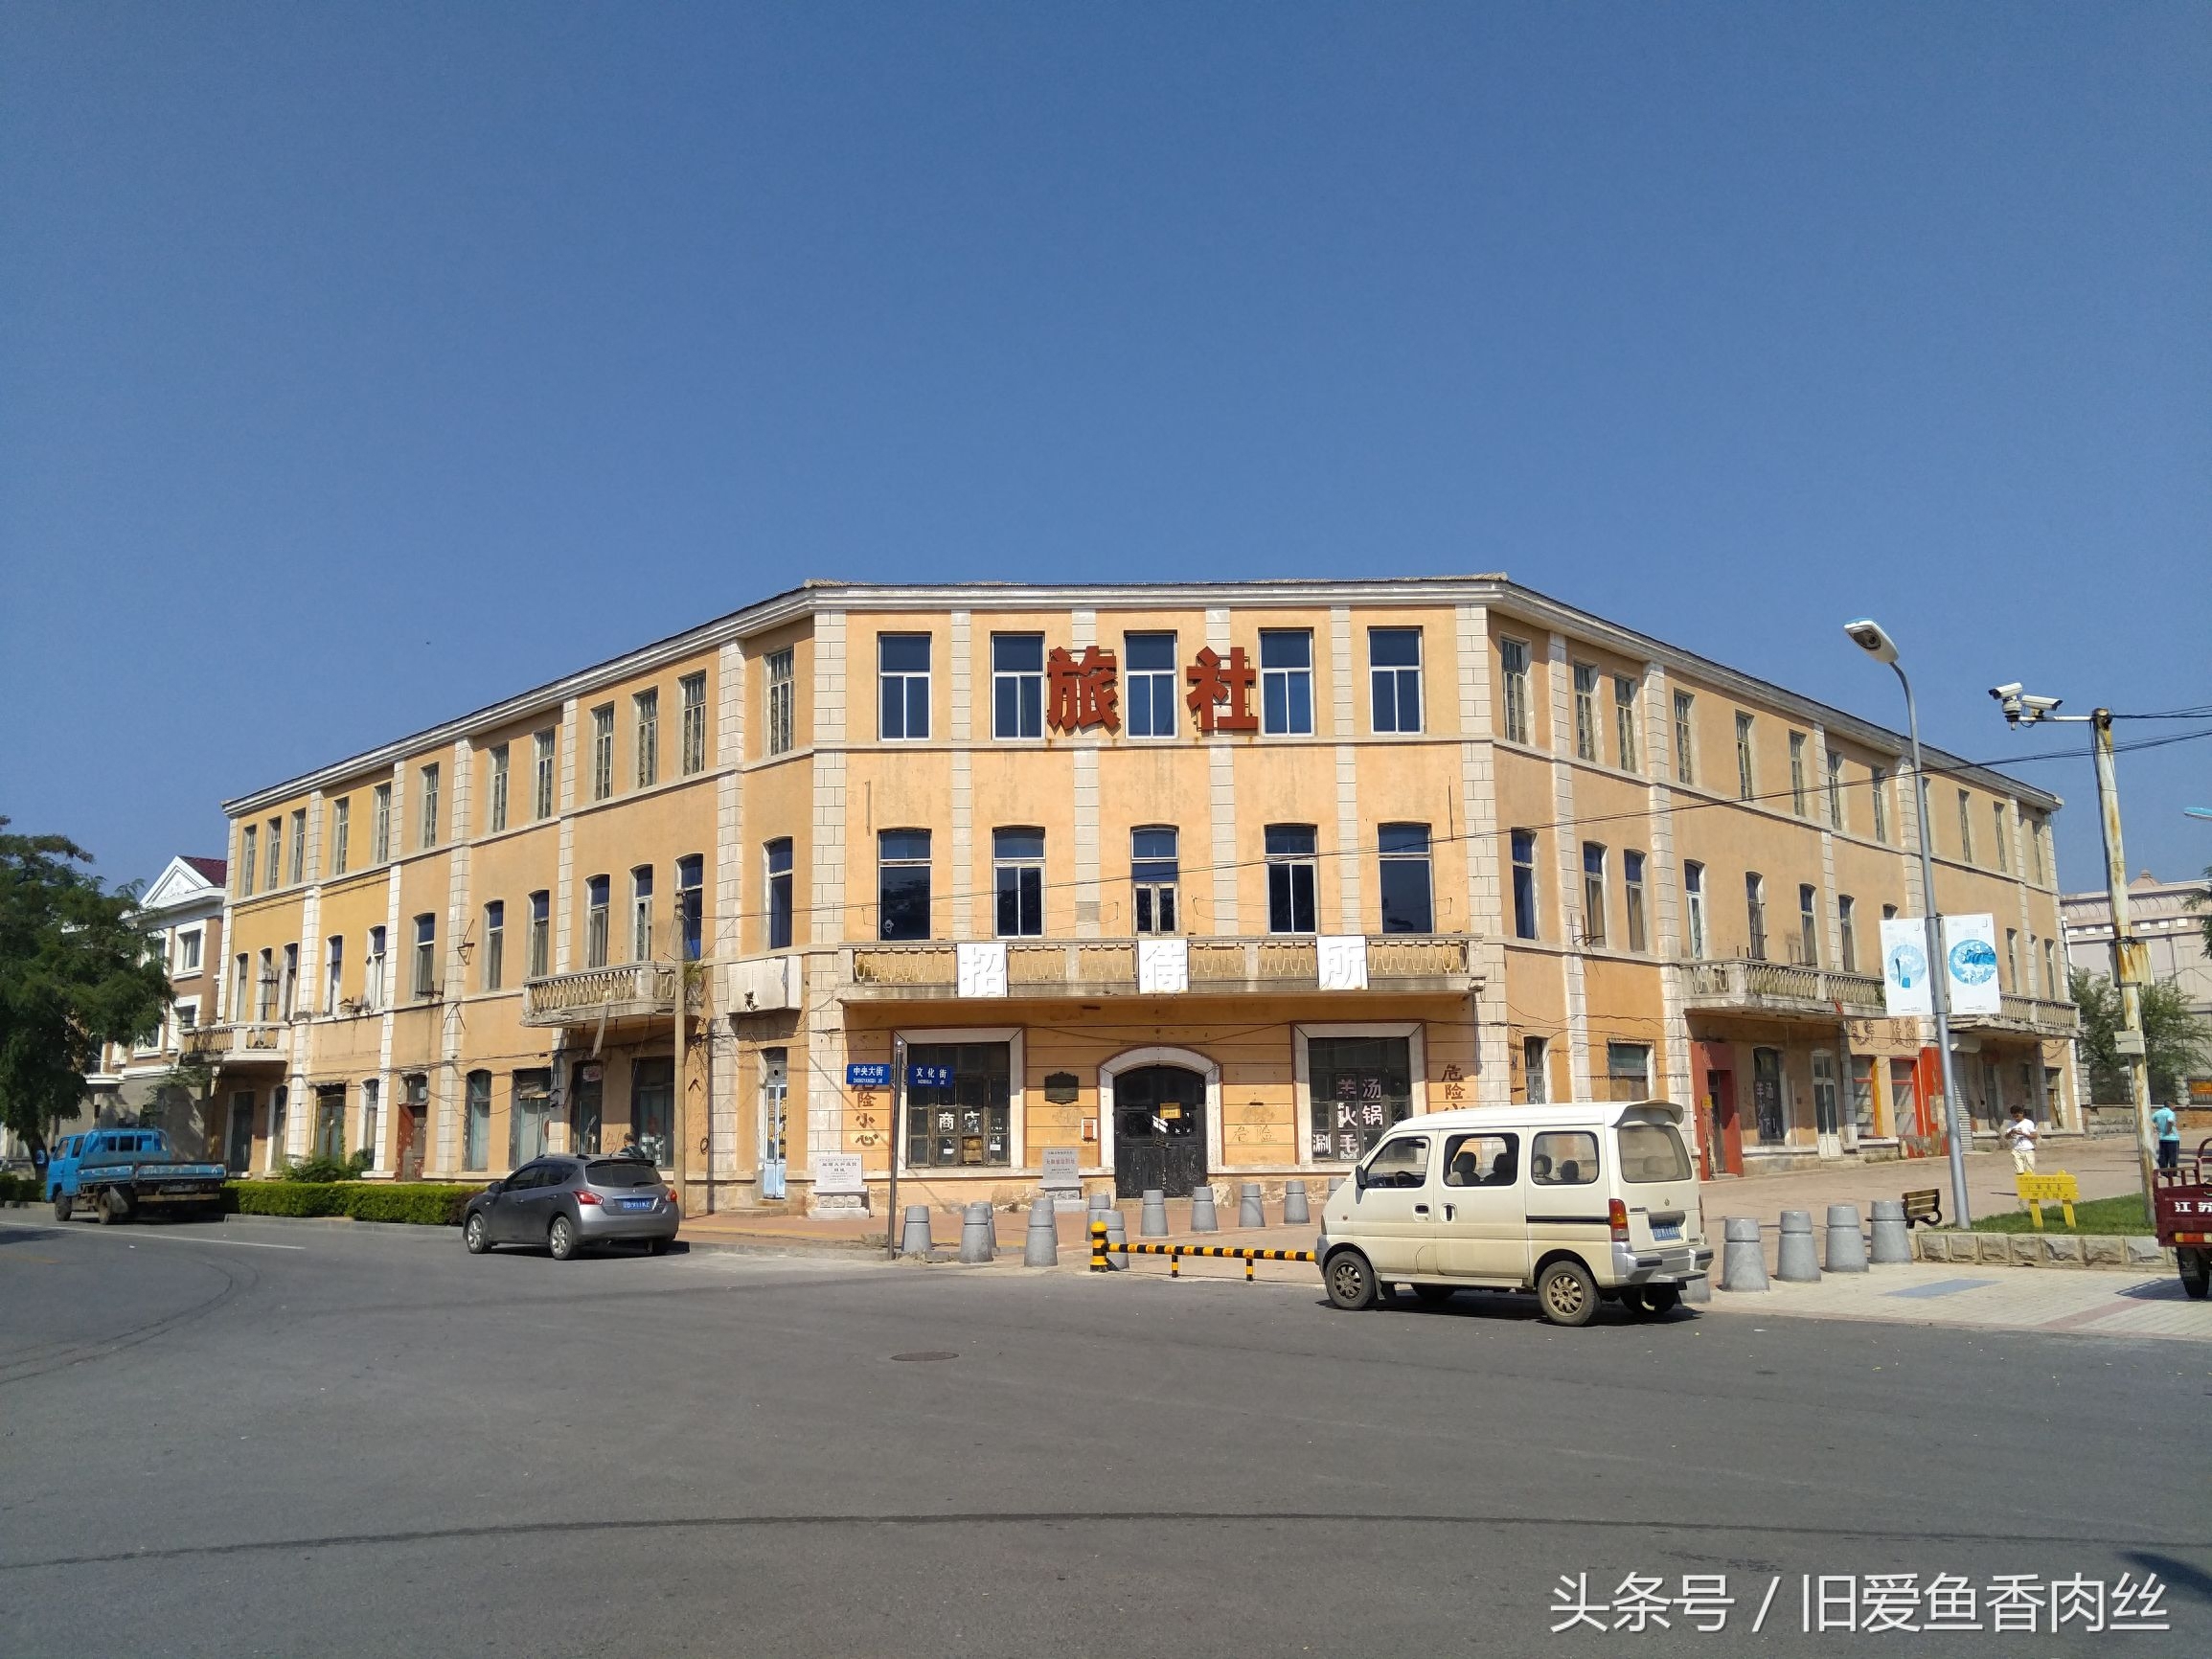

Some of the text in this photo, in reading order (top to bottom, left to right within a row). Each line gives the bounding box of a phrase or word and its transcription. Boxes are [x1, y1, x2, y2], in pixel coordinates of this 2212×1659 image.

[1047, 646, 1258, 735] 旅社
[961, 942, 1367, 997] 招待所
[853, 1065, 883, 1077] 中央大街
[916, 1067, 947, 1079] 文化街
[1337, 1078, 1381, 1100] 羊汤
[1337, 1102, 1383, 1128] 火锅
